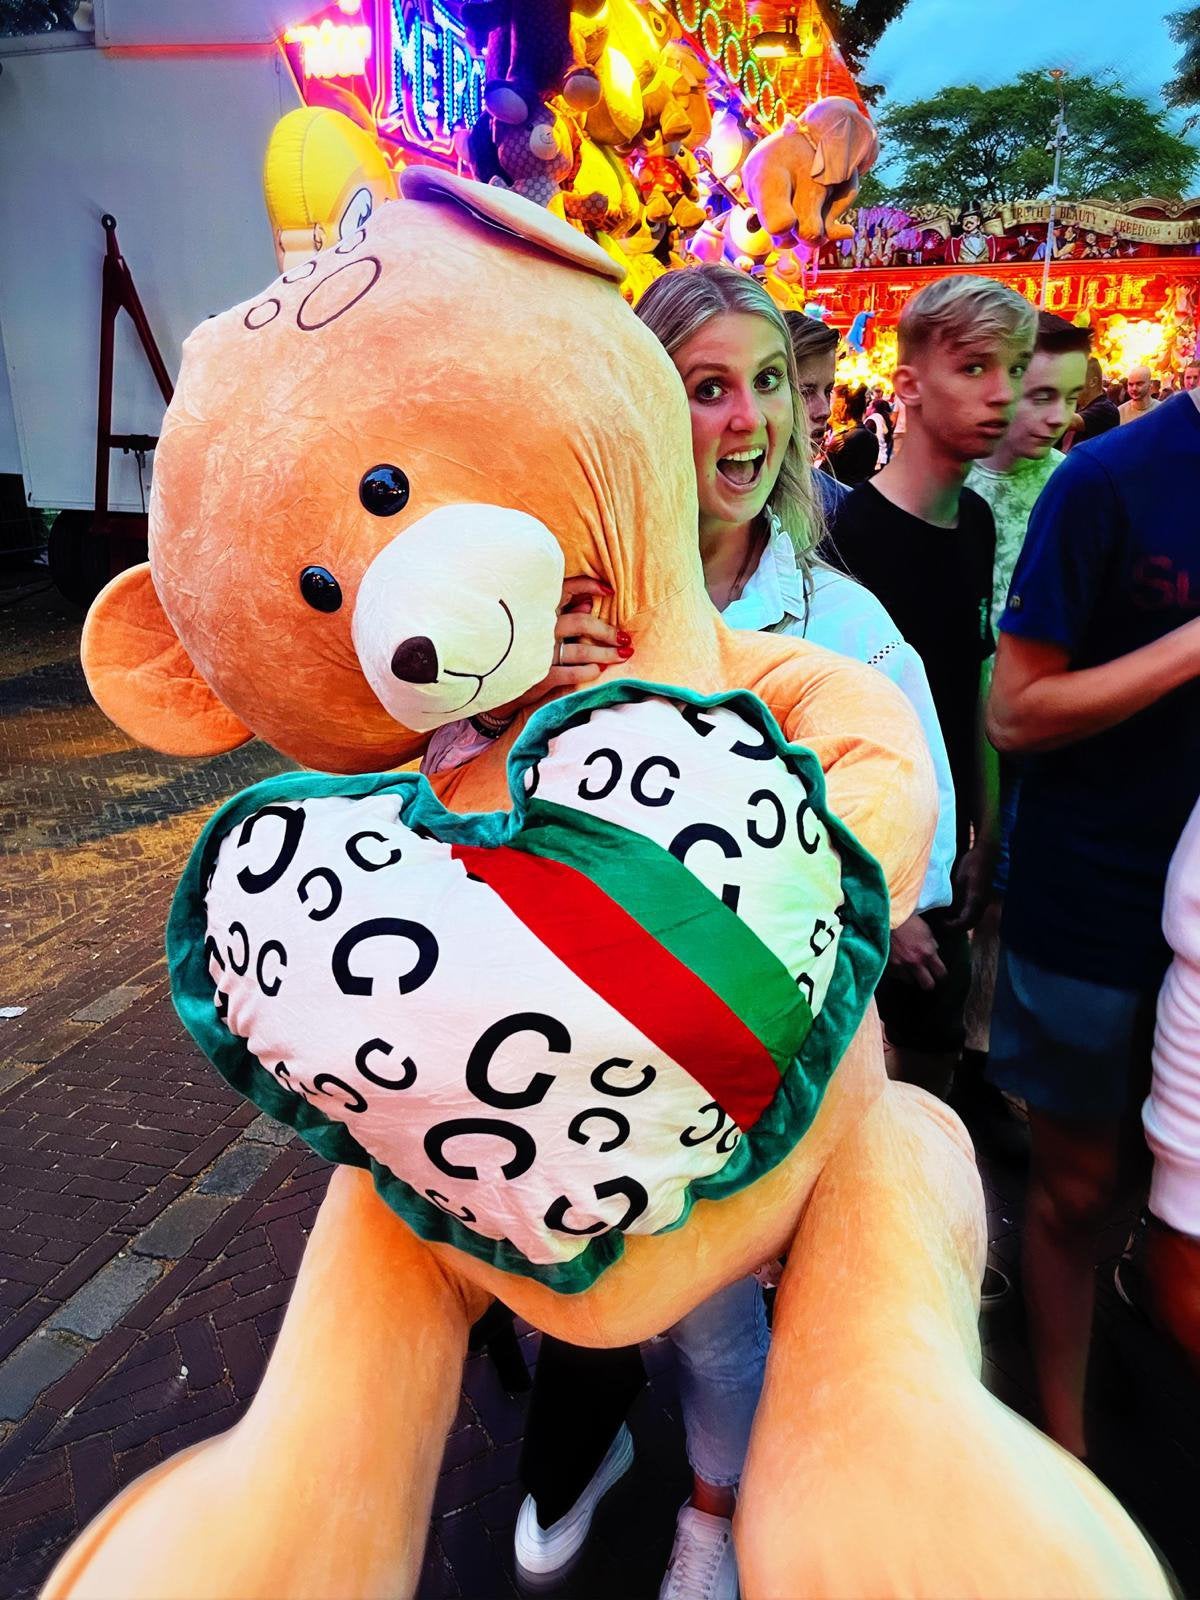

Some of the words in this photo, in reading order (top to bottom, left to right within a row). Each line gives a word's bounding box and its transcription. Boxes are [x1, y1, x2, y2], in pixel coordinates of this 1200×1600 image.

[1060, 206, 1097, 225] BEAUTY
[1114, 219, 1161, 238] FREEDOM
[1177, 226, 1200, 240] LOV
